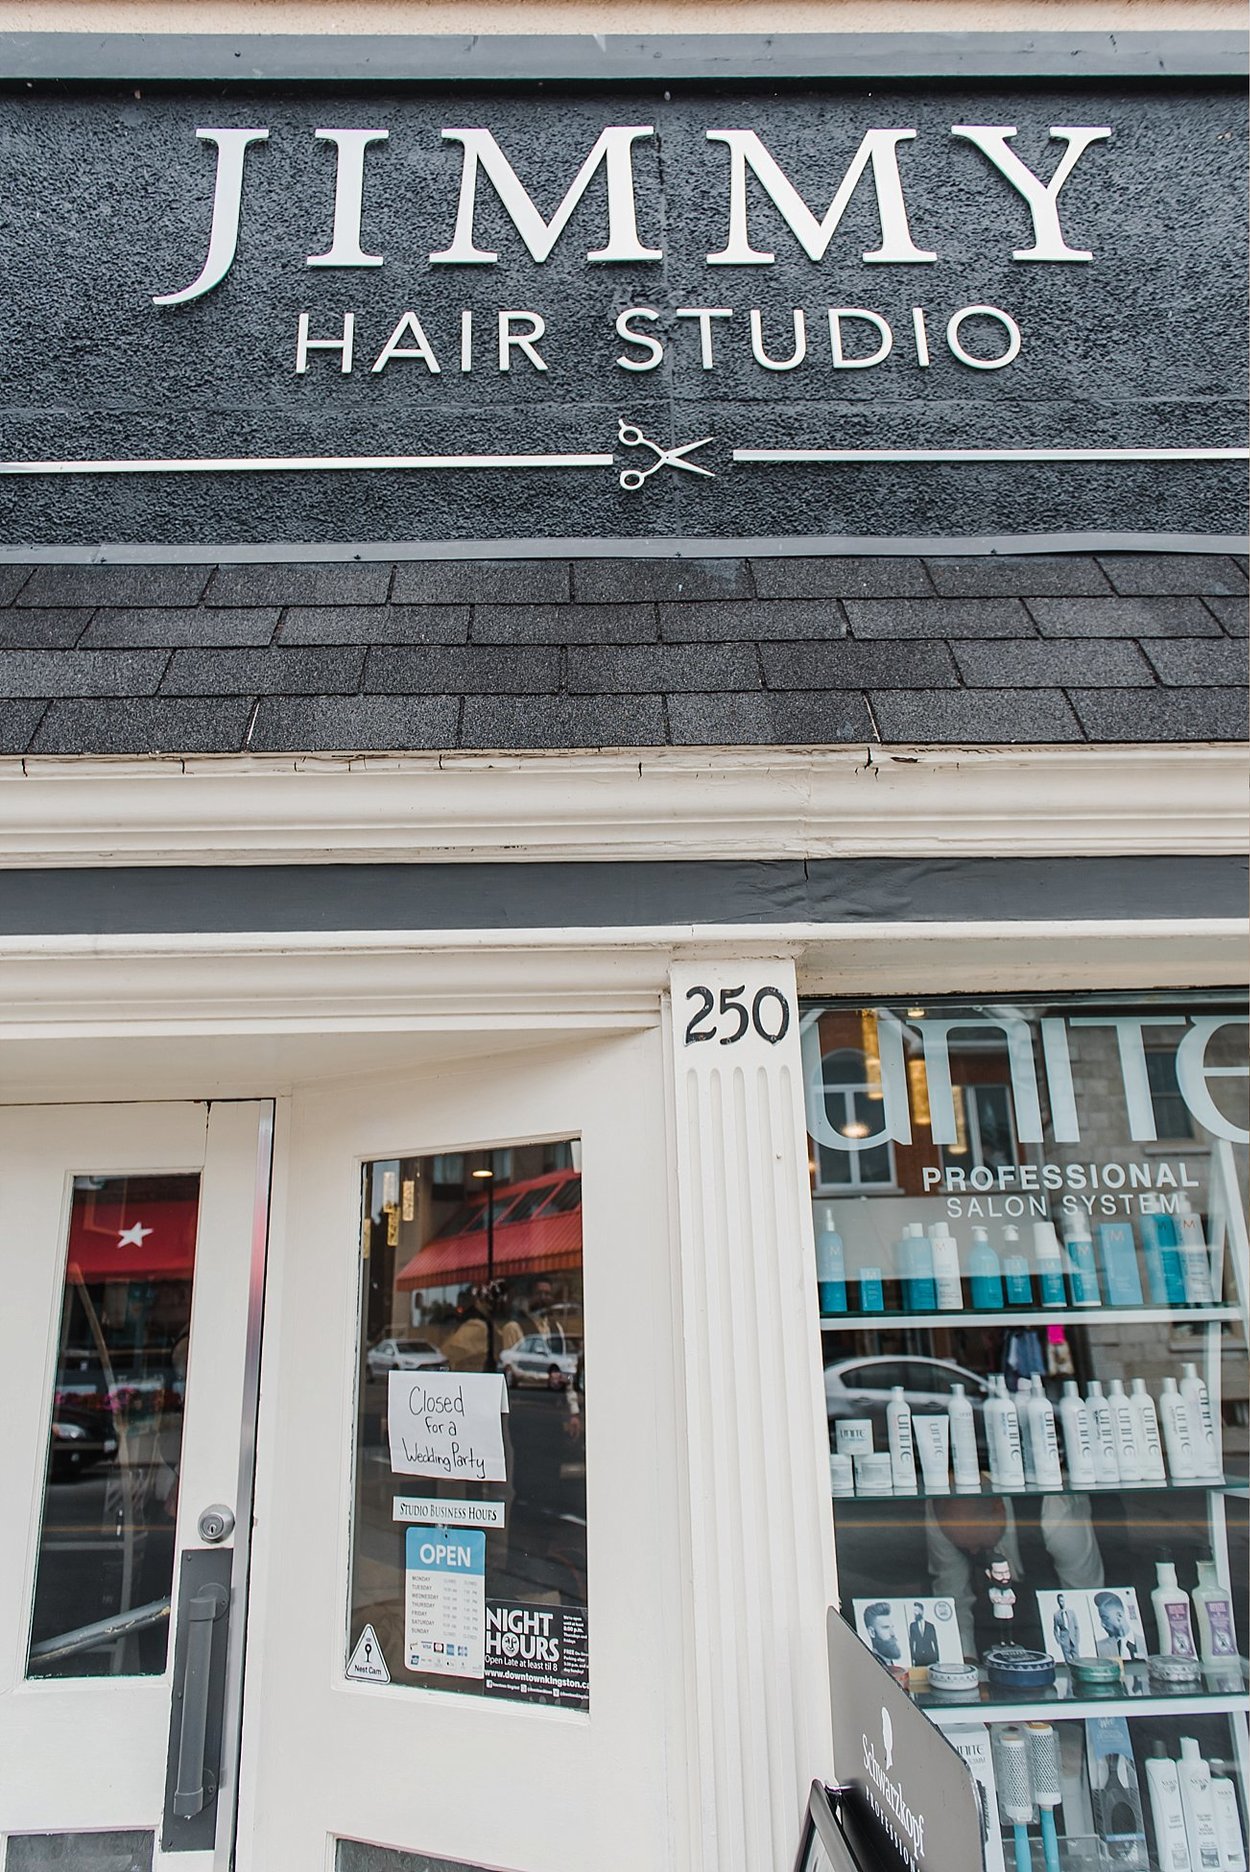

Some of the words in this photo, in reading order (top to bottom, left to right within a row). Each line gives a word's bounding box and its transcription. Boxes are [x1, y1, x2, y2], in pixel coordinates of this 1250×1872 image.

[152, 125, 1112, 306] JIMMY
[295, 310, 548, 374] HAIR
[615, 305, 1023, 371] STUDIO
[684, 985, 791, 1046] 250
[922, 1162, 1199, 1192] PROFESSIONAL
[947, 1196, 1047, 1218] SALON
[1063, 1194, 1182, 1216] SYSTEM
[409, 1385, 464, 1417] Closed
[448, 1421, 457, 1436] a
[402, 1437, 451, 1472] Wedding
[451, 1442, 486, 1479] Party
[400, 1503, 429, 1516] STUDIO
[430, 1504, 466, 1519] BUSINESS
[420, 1543, 471, 1568] OPEN
[486, 1607, 553, 1636] NIGHT
[486, 1631, 560, 1662] HOURS
[354, 1664, 368, 1674] Nest
[369, 1666, 382, 1675] Cam
[485, 1654, 503, 1665] Open
[504, 1657, 519, 1667] Late
[520, 1660, 527, 1668] at
[528, 1660, 544, 1670] least
[552, 1663, 558, 1672] 8
[862, 1733, 925, 1860] Schwarzkopf
